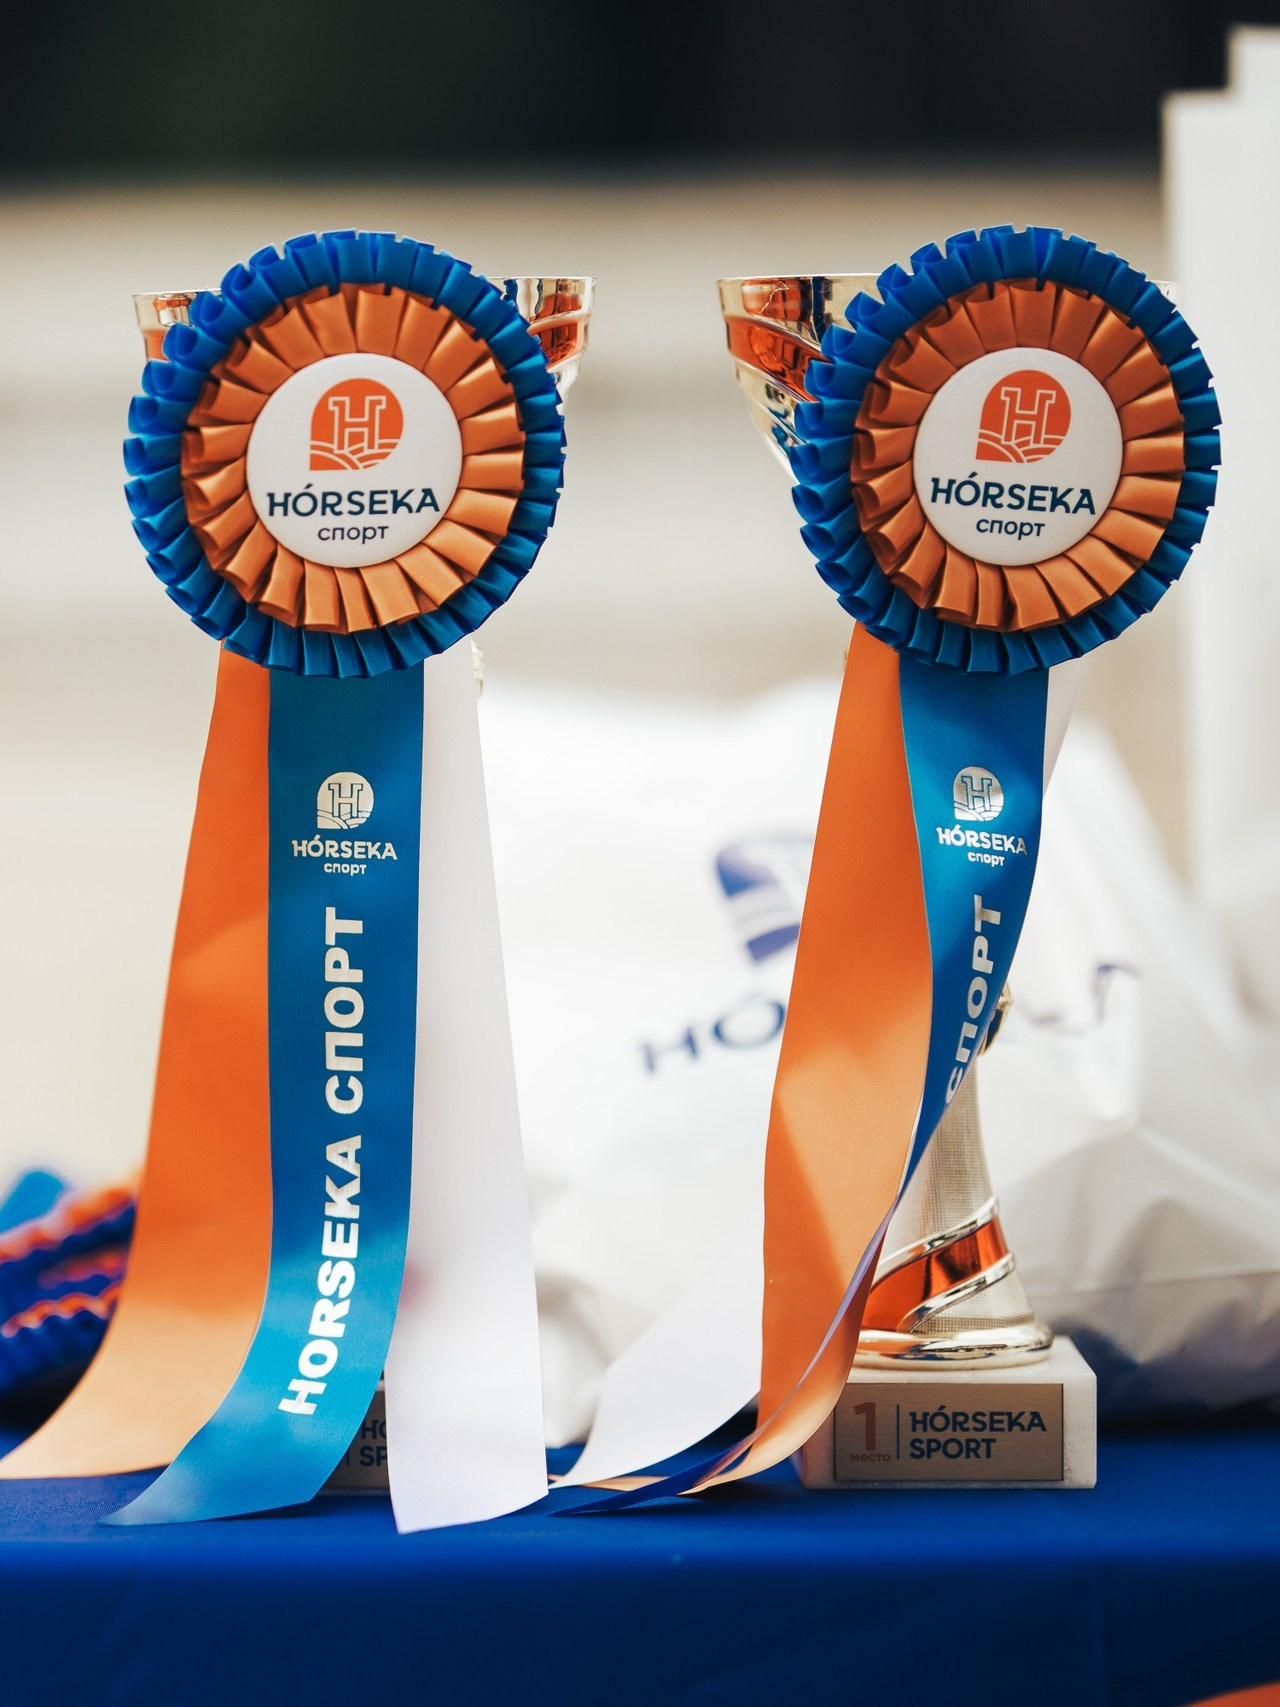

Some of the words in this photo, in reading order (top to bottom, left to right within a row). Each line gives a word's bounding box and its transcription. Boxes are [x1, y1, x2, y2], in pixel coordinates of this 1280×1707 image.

[267, 483, 440, 518] HÓRSEKA
[930, 472, 1096, 516] HÓRSEKA
[317, 525, 389, 544] спорт
[976, 518, 1046, 541] спорт
[291, 834, 397, 860] HÓRSEKA
[936, 824, 1027, 855] HÓRSEKA
[323, 862, 367, 877] спорт
[967, 851, 1005, 867] спорт
[945, 894, 1002, 1104] СПОРТ
[277, 1134, 363, 1415] HORSEKA
[323, 906, 364, 1115] СПОРТ
[854, 1402, 876, 1450] 1
[909, 1405, 1047, 1433] HÓRSEKA
[850, 1452, 891, 1462] место
[909, 1438, 996, 1459] SPORT
